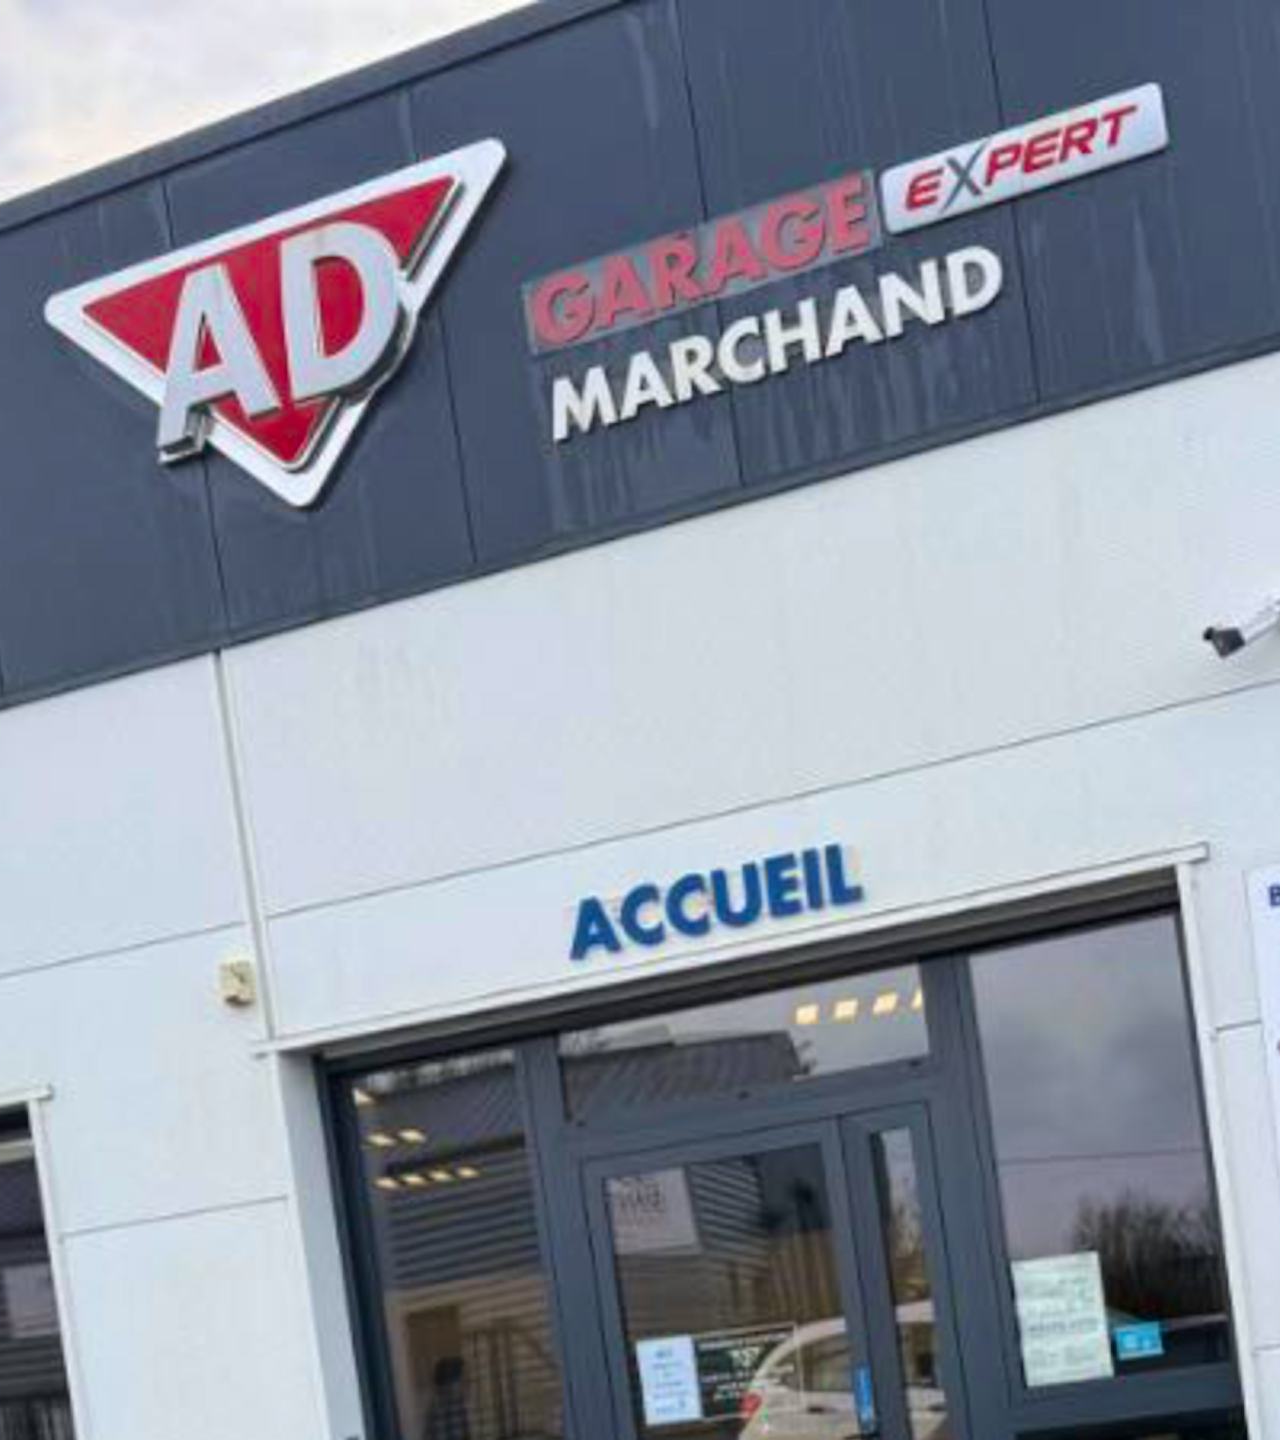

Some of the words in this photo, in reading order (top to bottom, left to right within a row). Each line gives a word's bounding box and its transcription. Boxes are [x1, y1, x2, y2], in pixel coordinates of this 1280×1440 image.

[532, 172, 875, 346] GARAGE
[906, 104, 1137, 216] EXPERT
[157, 220, 402, 462] AD
[553, 245, 1003, 442] MARCHAND
[570, 844, 864, 960] ACCUEIL
